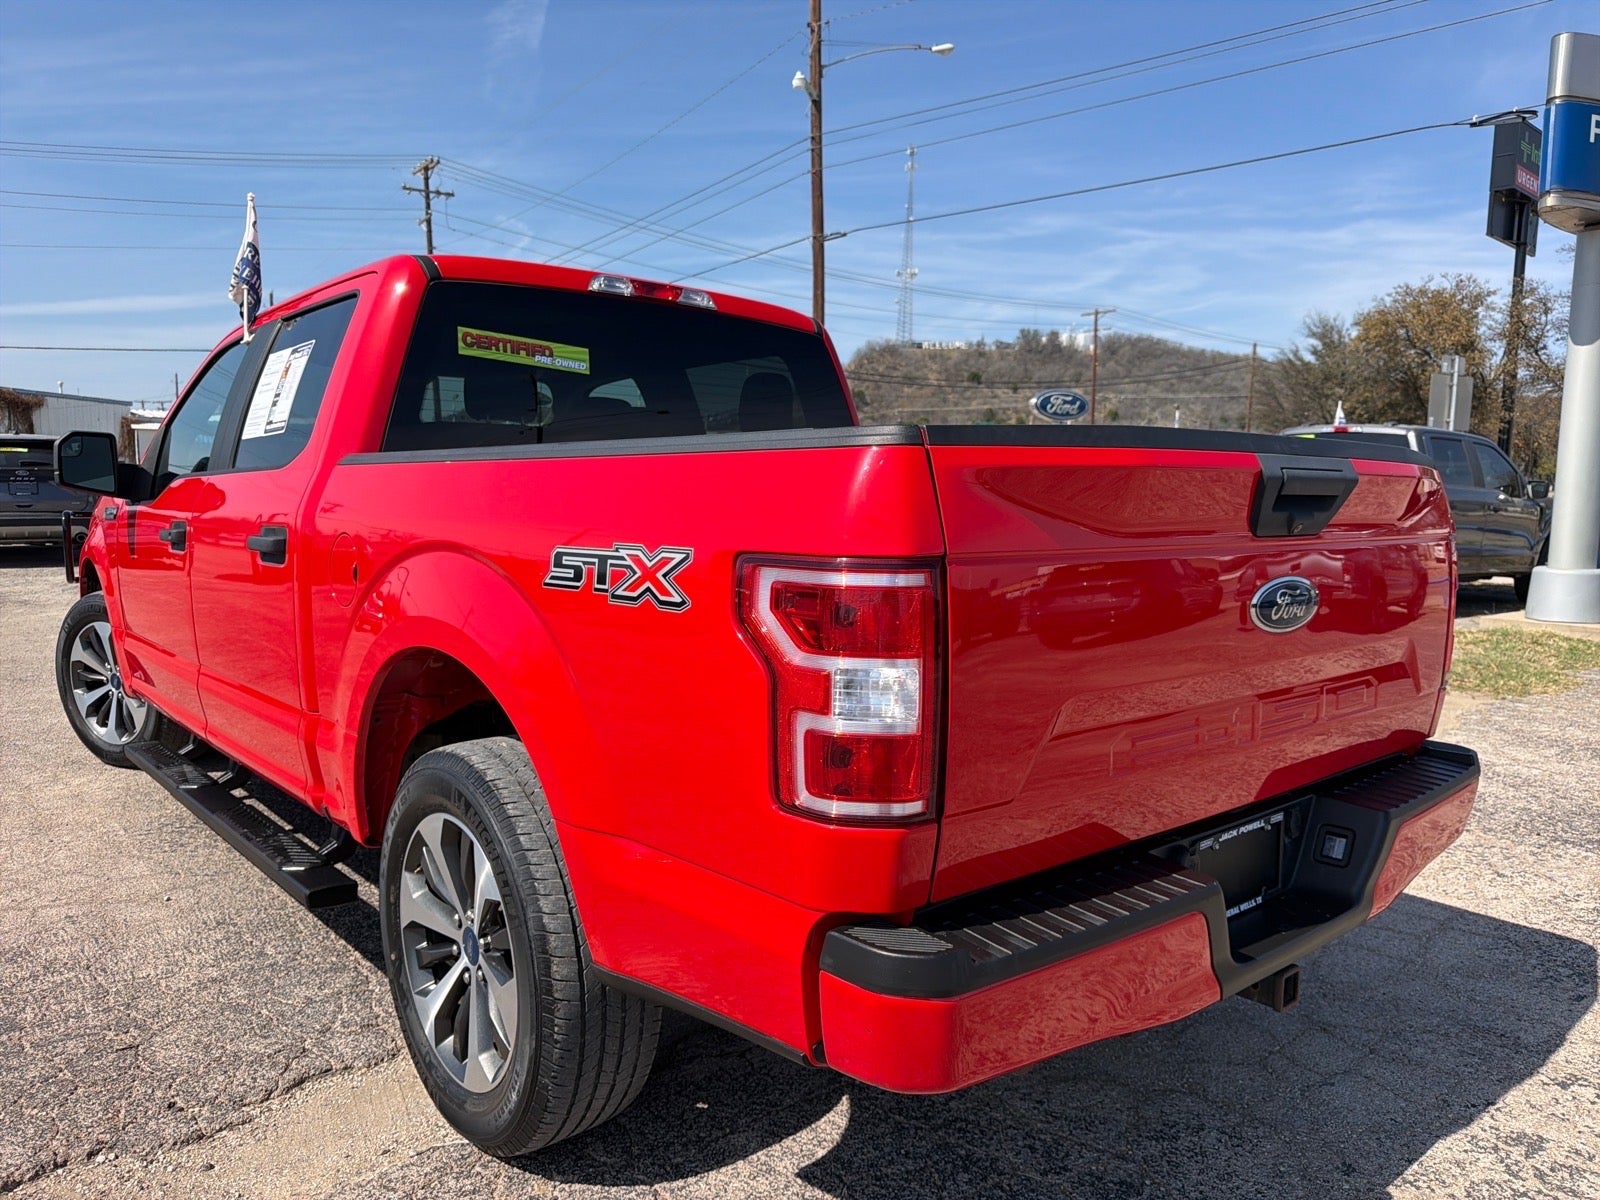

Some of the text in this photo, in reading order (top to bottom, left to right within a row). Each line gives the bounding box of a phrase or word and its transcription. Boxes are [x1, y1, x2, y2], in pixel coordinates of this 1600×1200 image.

[1517, 169, 1539, 193] URGEN
[461, 331, 554, 358] CERTIFIED
[534, 355, 587, 370] PRE-OWNED
[1046, 395, 1081, 414] Ford
[542, 542, 694, 613] STX
[1271, 589, 1307, 620] Ford
[1219, 820, 1265, 842] JACK POWELL
